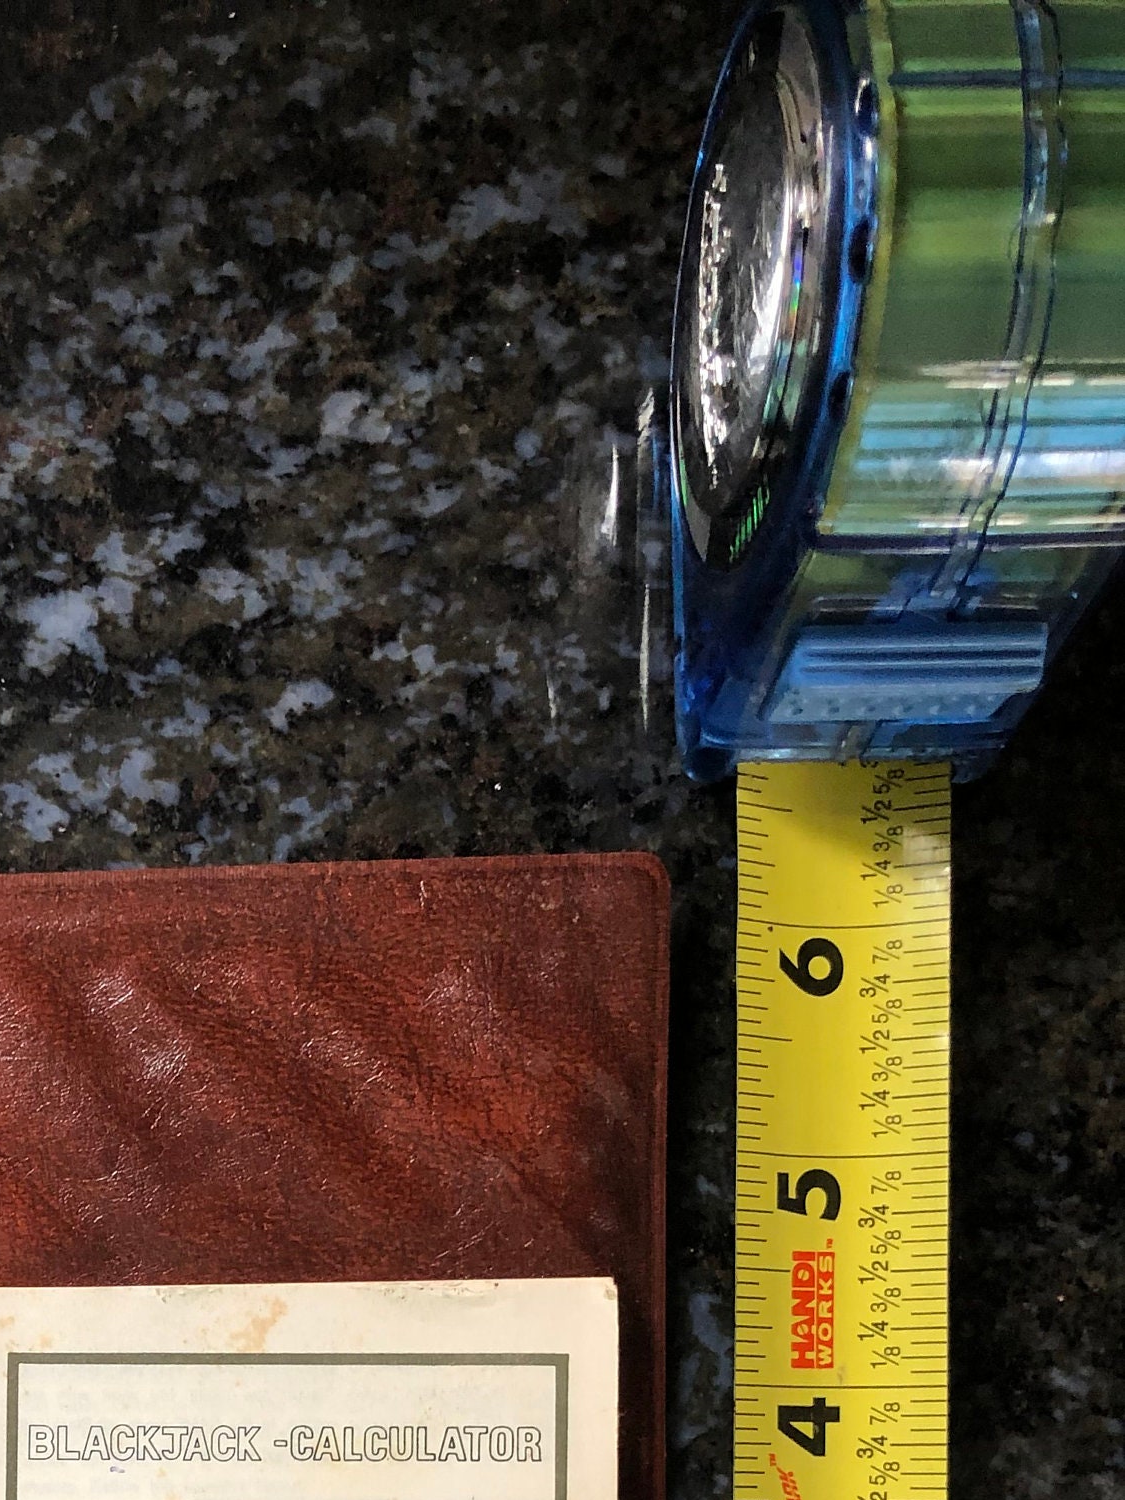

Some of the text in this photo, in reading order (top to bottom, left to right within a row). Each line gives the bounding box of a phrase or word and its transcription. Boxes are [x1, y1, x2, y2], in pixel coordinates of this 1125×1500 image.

[778, 936, 844, 997] 6
[776, 1168, 842, 1222] 5
[791, 1251, 815, 1368] HANDI
[817, 1256, 834, 1364] WORKS
[28, 1424, 262, 1462] BLACKJACK
[777, 1397, 841, 1457] 4
